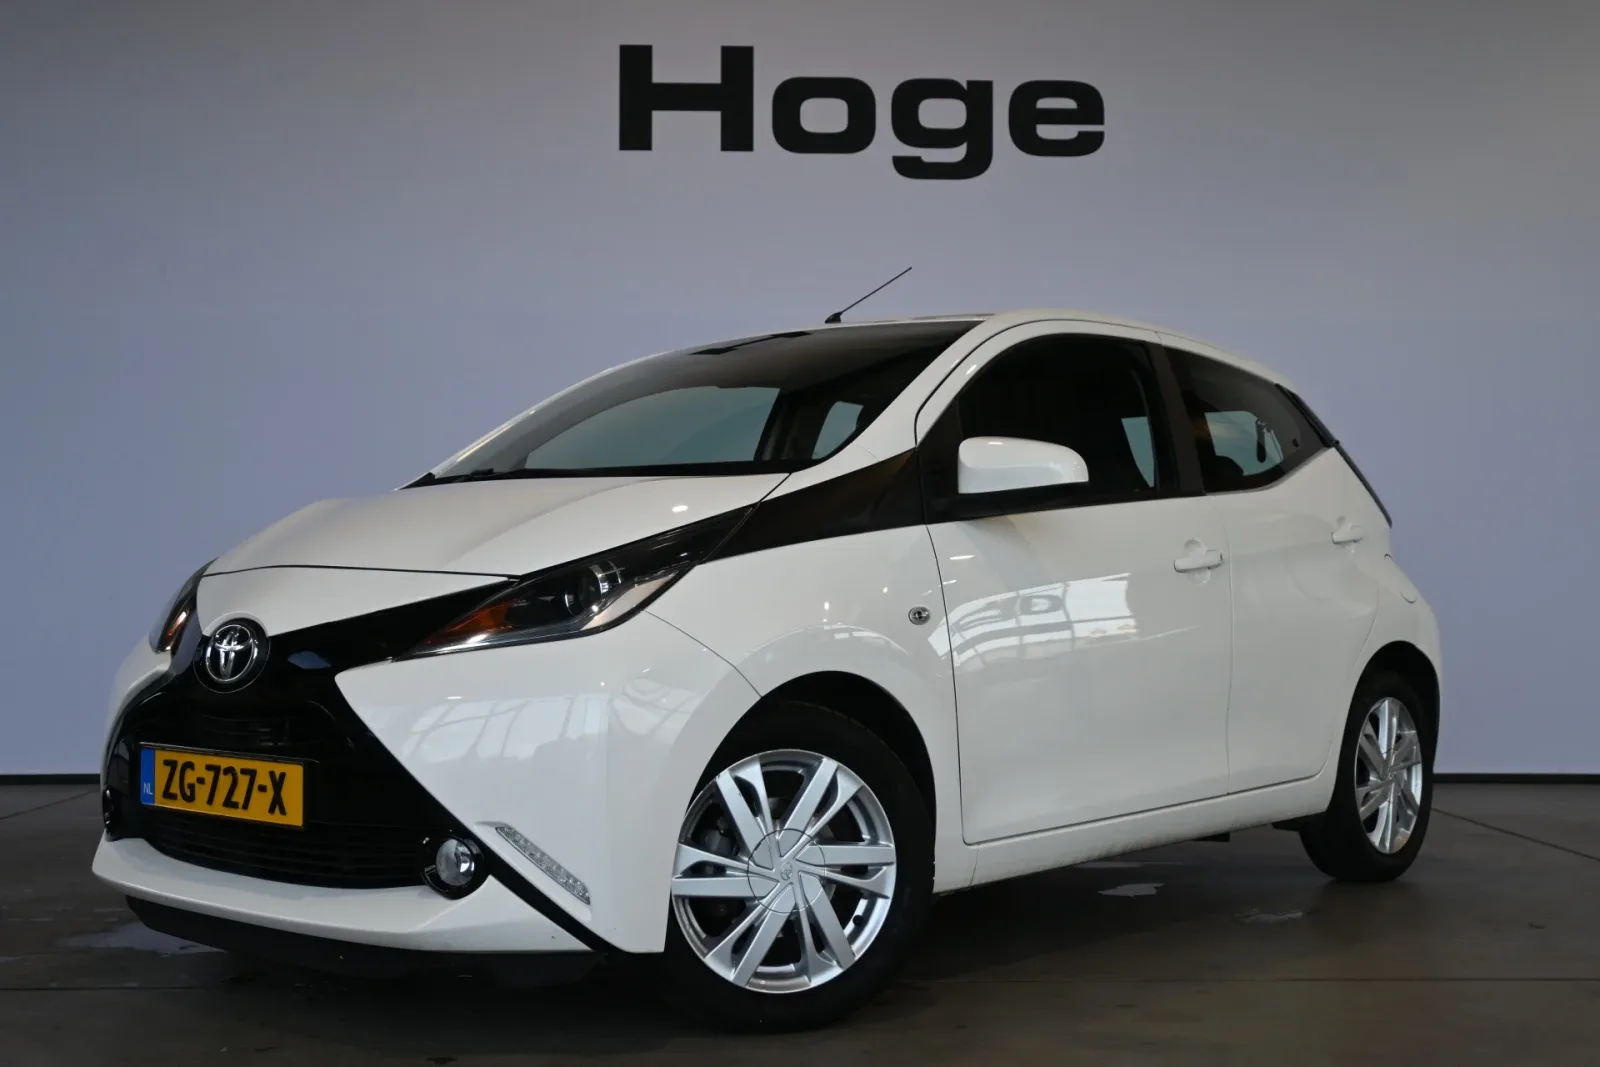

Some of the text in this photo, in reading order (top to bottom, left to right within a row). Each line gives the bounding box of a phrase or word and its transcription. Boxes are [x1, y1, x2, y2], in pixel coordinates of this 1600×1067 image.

[619, 45, 1105, 180] Hoge
[143, 782, 153, 795] NL
[162, 759, 287, 816] ZG-727-X
